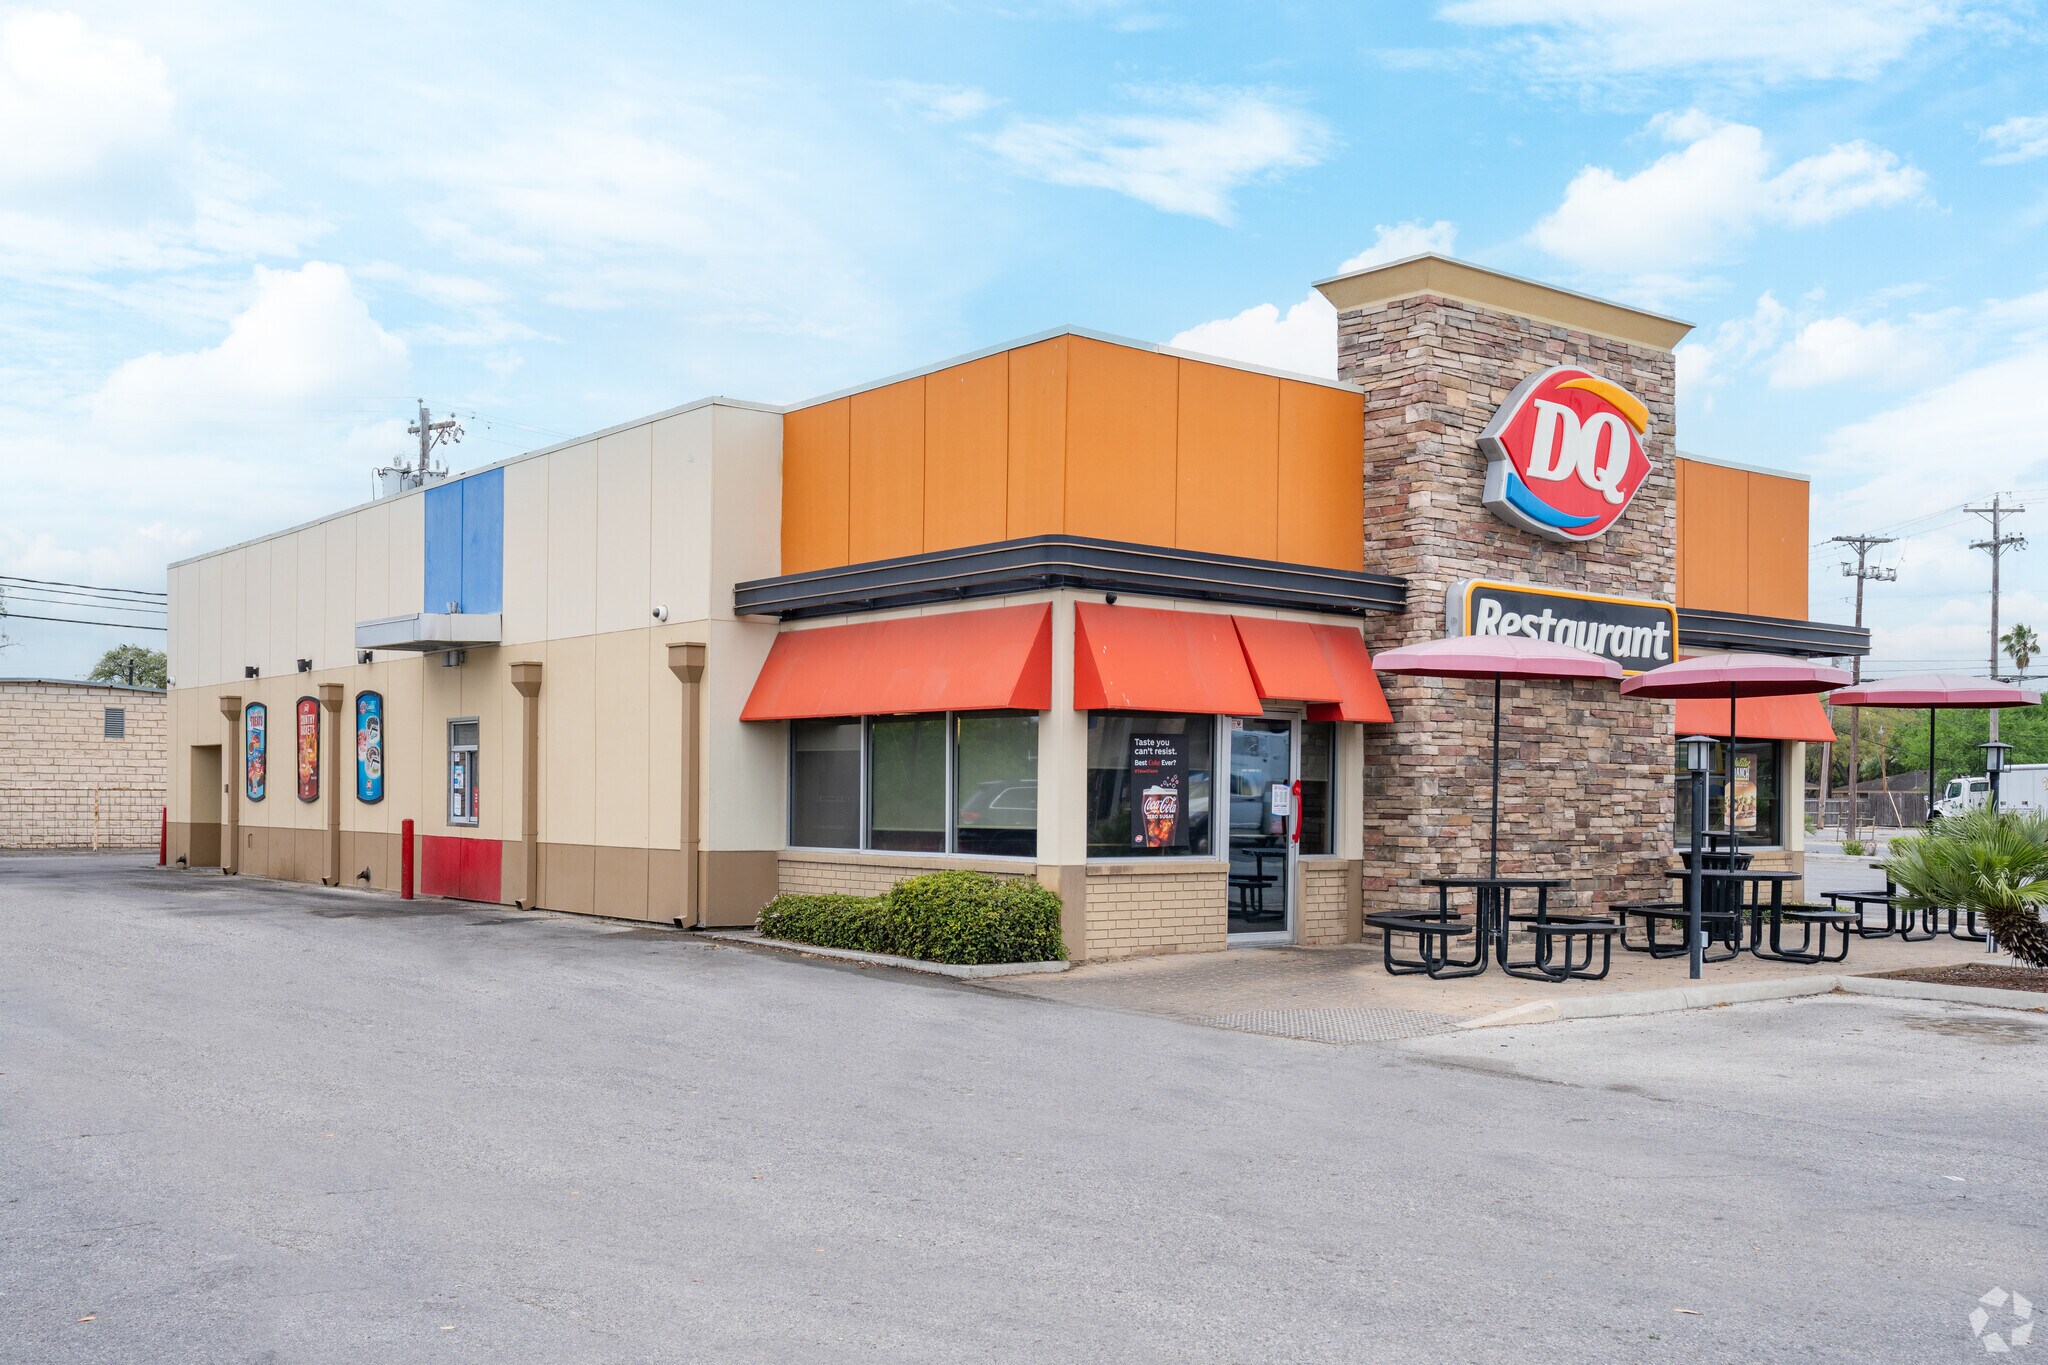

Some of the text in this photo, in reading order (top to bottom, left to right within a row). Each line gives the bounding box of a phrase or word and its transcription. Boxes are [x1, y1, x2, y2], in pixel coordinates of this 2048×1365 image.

[1526, 398, 1632, 505] DQ
[1475, 598, 1671, 660] Restaurant
[1134, 738, 1170, 748] Taste you
[1134, 747, 1178, 755] can't resist.
